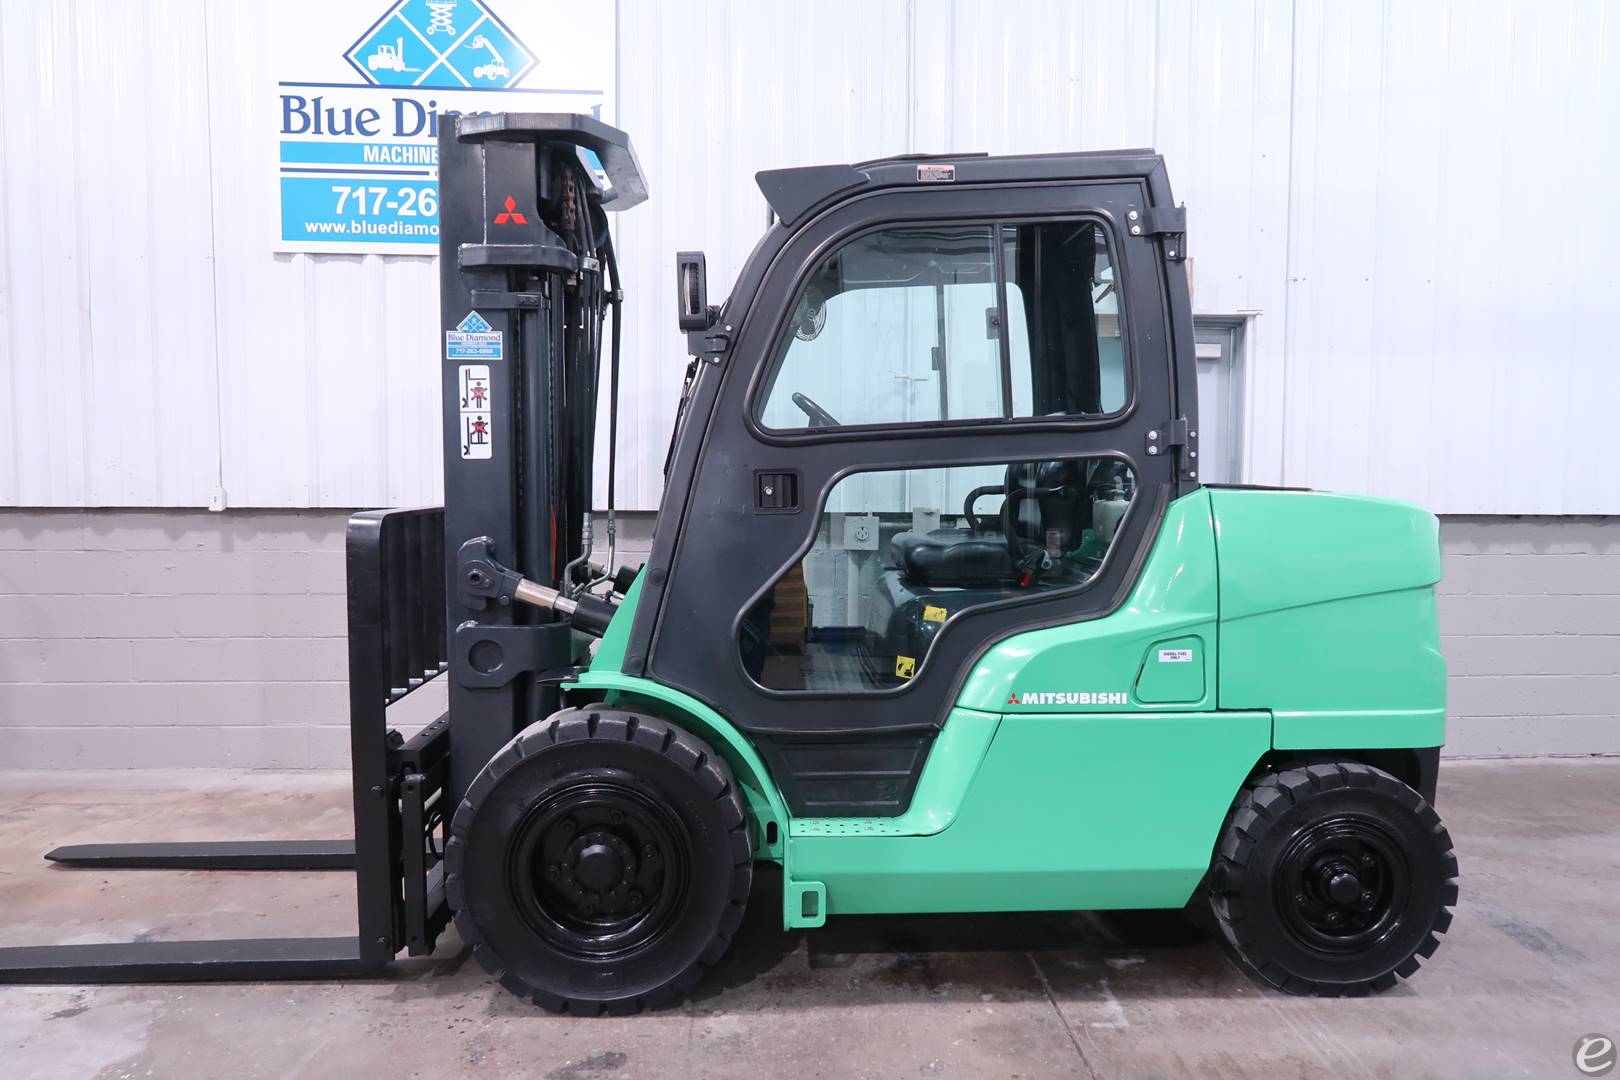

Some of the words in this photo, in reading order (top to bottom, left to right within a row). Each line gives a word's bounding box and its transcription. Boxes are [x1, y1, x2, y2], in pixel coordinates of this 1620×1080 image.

[280, 94, 381, 136] Blue
[466, 333, 501, 341] Diamond
[1021, 692, 1128, 704] MITSUBISHI
